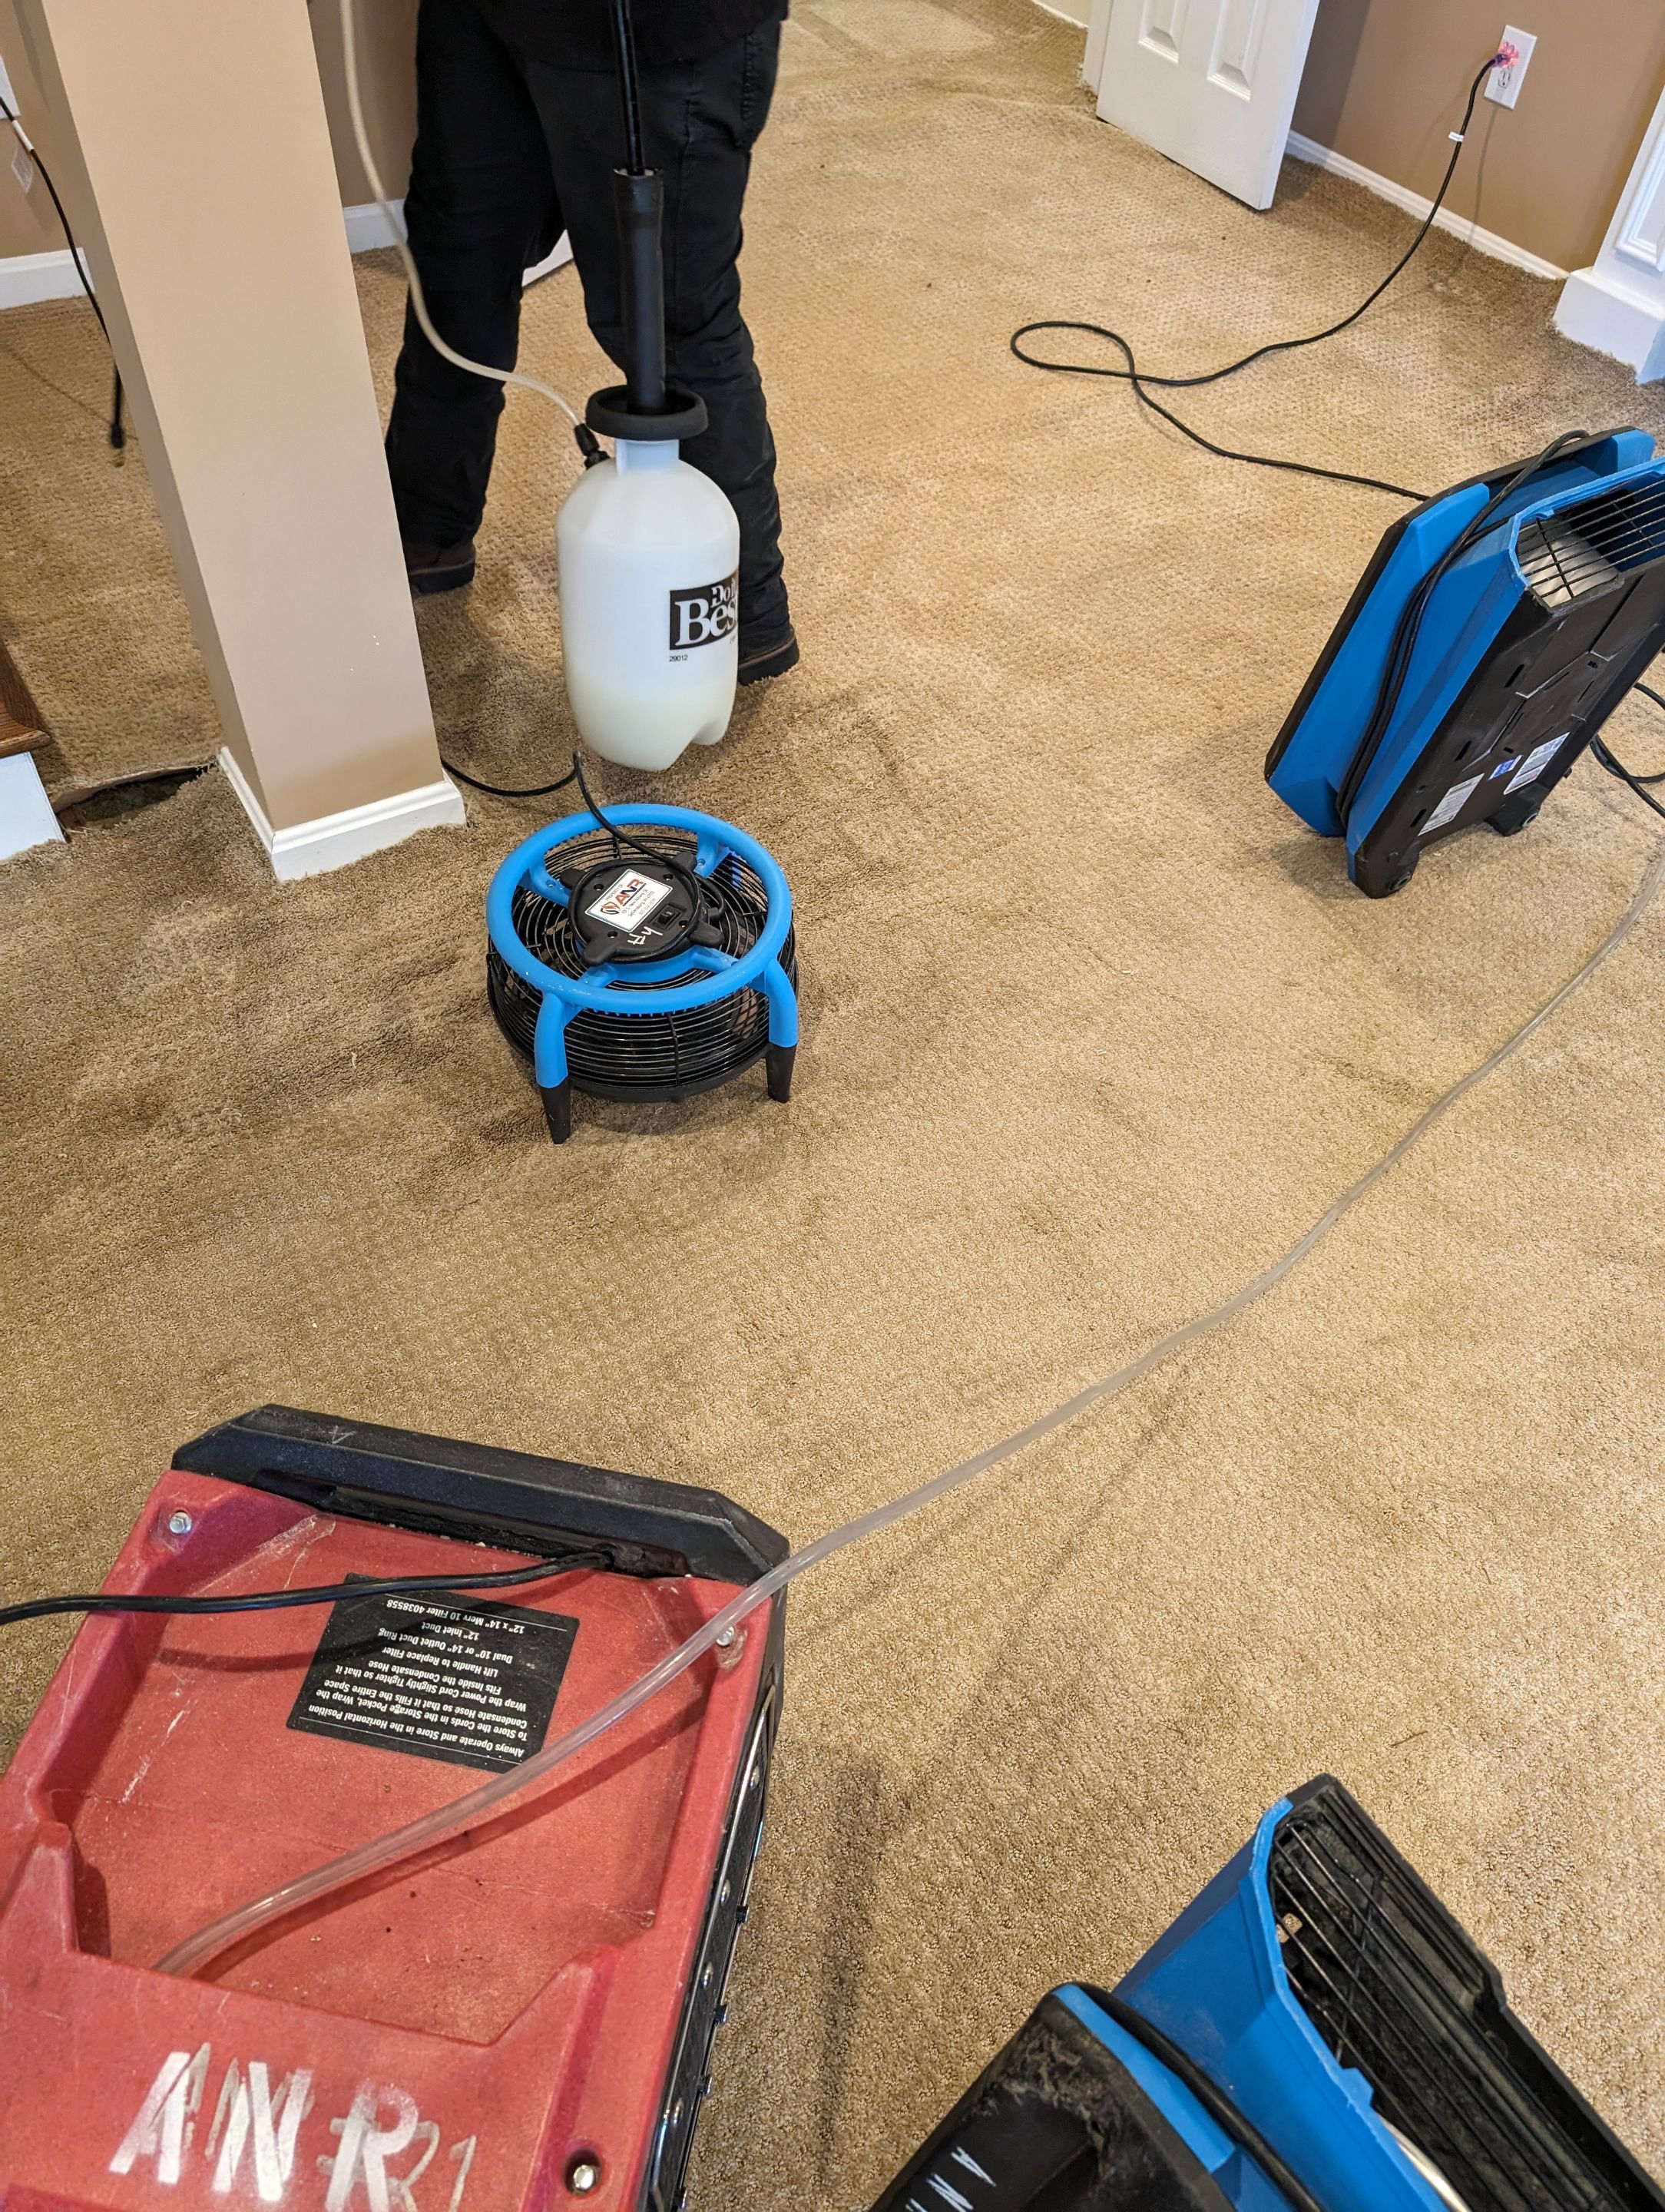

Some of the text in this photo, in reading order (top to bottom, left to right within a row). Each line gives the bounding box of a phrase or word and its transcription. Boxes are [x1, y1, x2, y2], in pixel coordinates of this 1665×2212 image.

[674, 598, 738, 646] Bes
[615, 879, 644, 905] ANR
[386, 1598, 425, 1614] 4038558
[425, 1607, 449, 1618] Filter
[449, 1611, 462, 1621] 10
[462, 1614, 484, 1626] Merv
[421, 1621, 479, 1641] 12" Inlet Duct
[485, 1620, 501, 1629] 14"
[508, 1624, 525, 1634] 12"
[377, 1628, 398, 1641] Ring
[399, 1633, 419, 1645] Duct
[420, 1637, 445, 1651] Outlet
[447, 1644, 464, 1654] 14"
[382, 1646, 498, 1677] Lift Handle to Replace Filter
[475, 1650, 492, 1659] 10"
[492, 1652, 513, 1664] Dual
[368, 1660, 501, 1695] Fits Inside the Condensate Hose
[335, 1665, 527, 1712] Wrap the Power Cord Slightly Tighter so that it
[324, 1679, 528, 1729] Condensate Hose so that it Fills the Entire Space
[316, 1689, 528, 1741] To Store the Cords in the Storage Pocket, Wrap the
[308, 1704, 525, 1757] Always Operate and Store in the Horizontal Position
